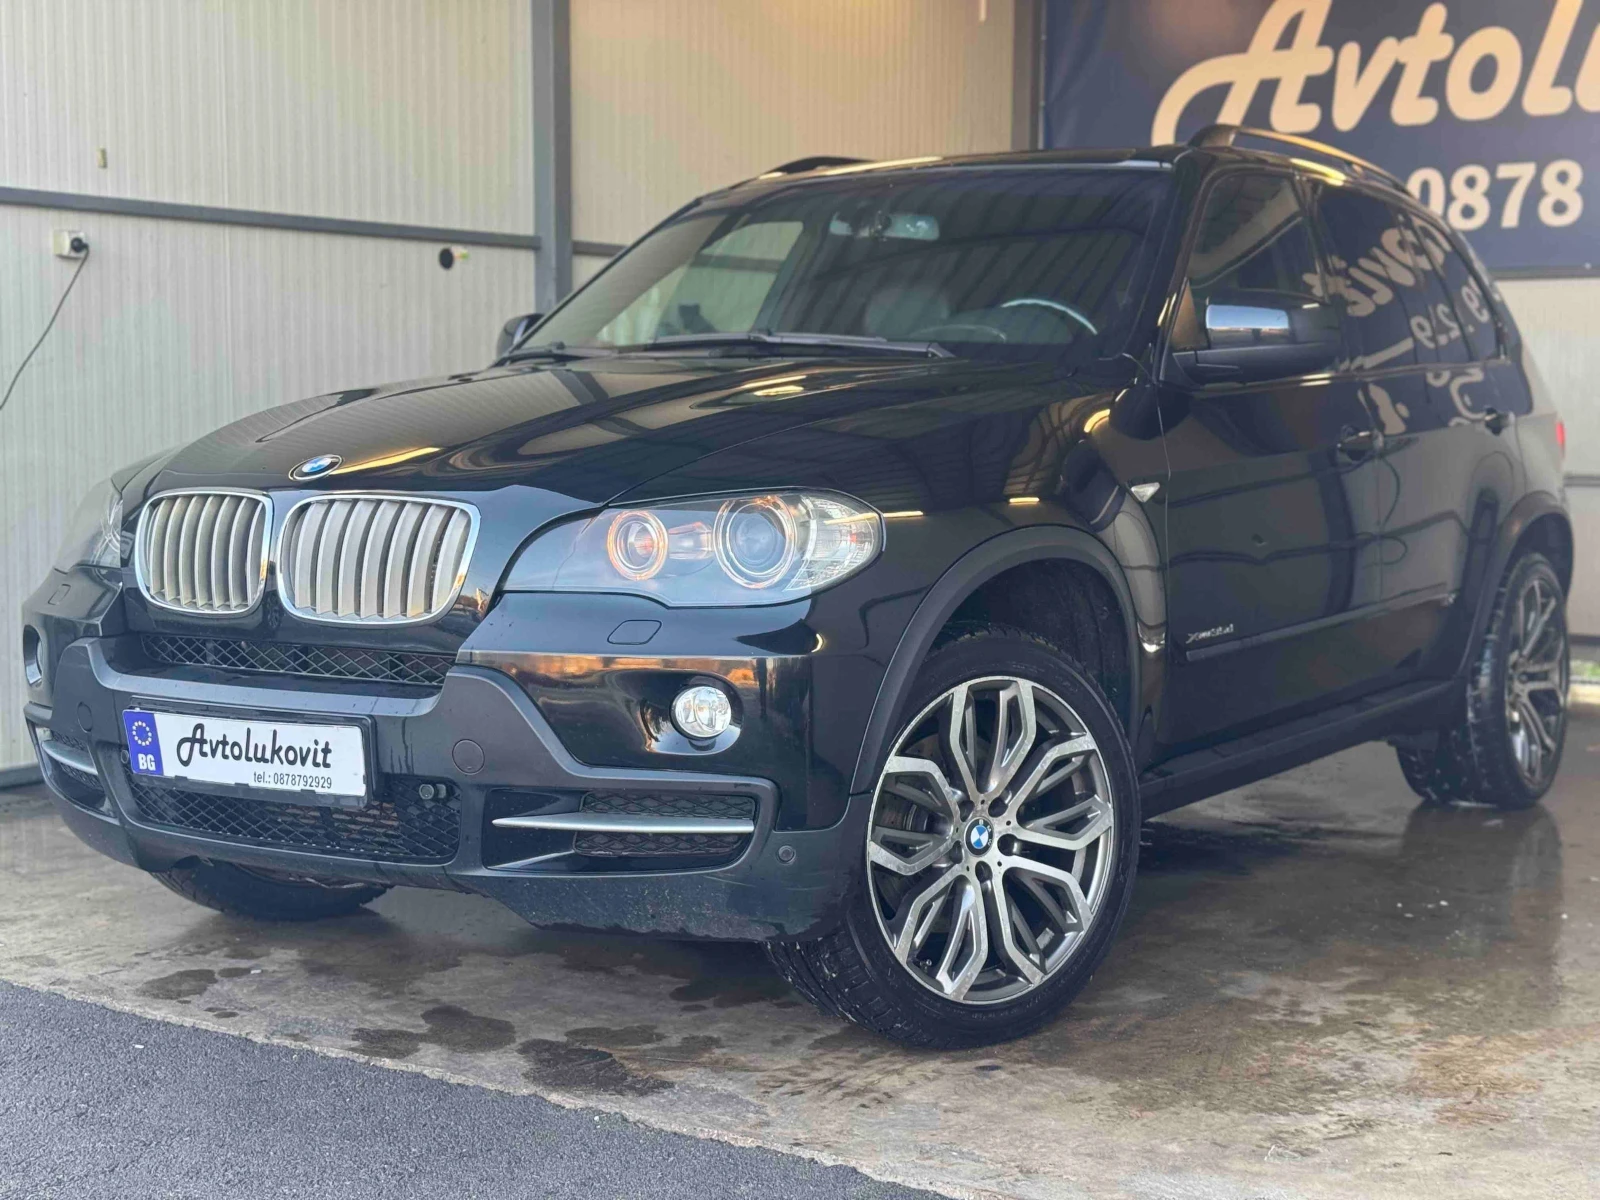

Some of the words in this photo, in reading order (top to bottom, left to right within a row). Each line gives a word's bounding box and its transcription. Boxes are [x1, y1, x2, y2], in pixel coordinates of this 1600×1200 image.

[1407, 159, 1584, 231] 0878
[176, 722, 332, 768] Avtolukovit
[138, 753, 156, 771] BG
[253, 772, 271, 785] tel.:
[273, 774, 332, 789] 0878792929
